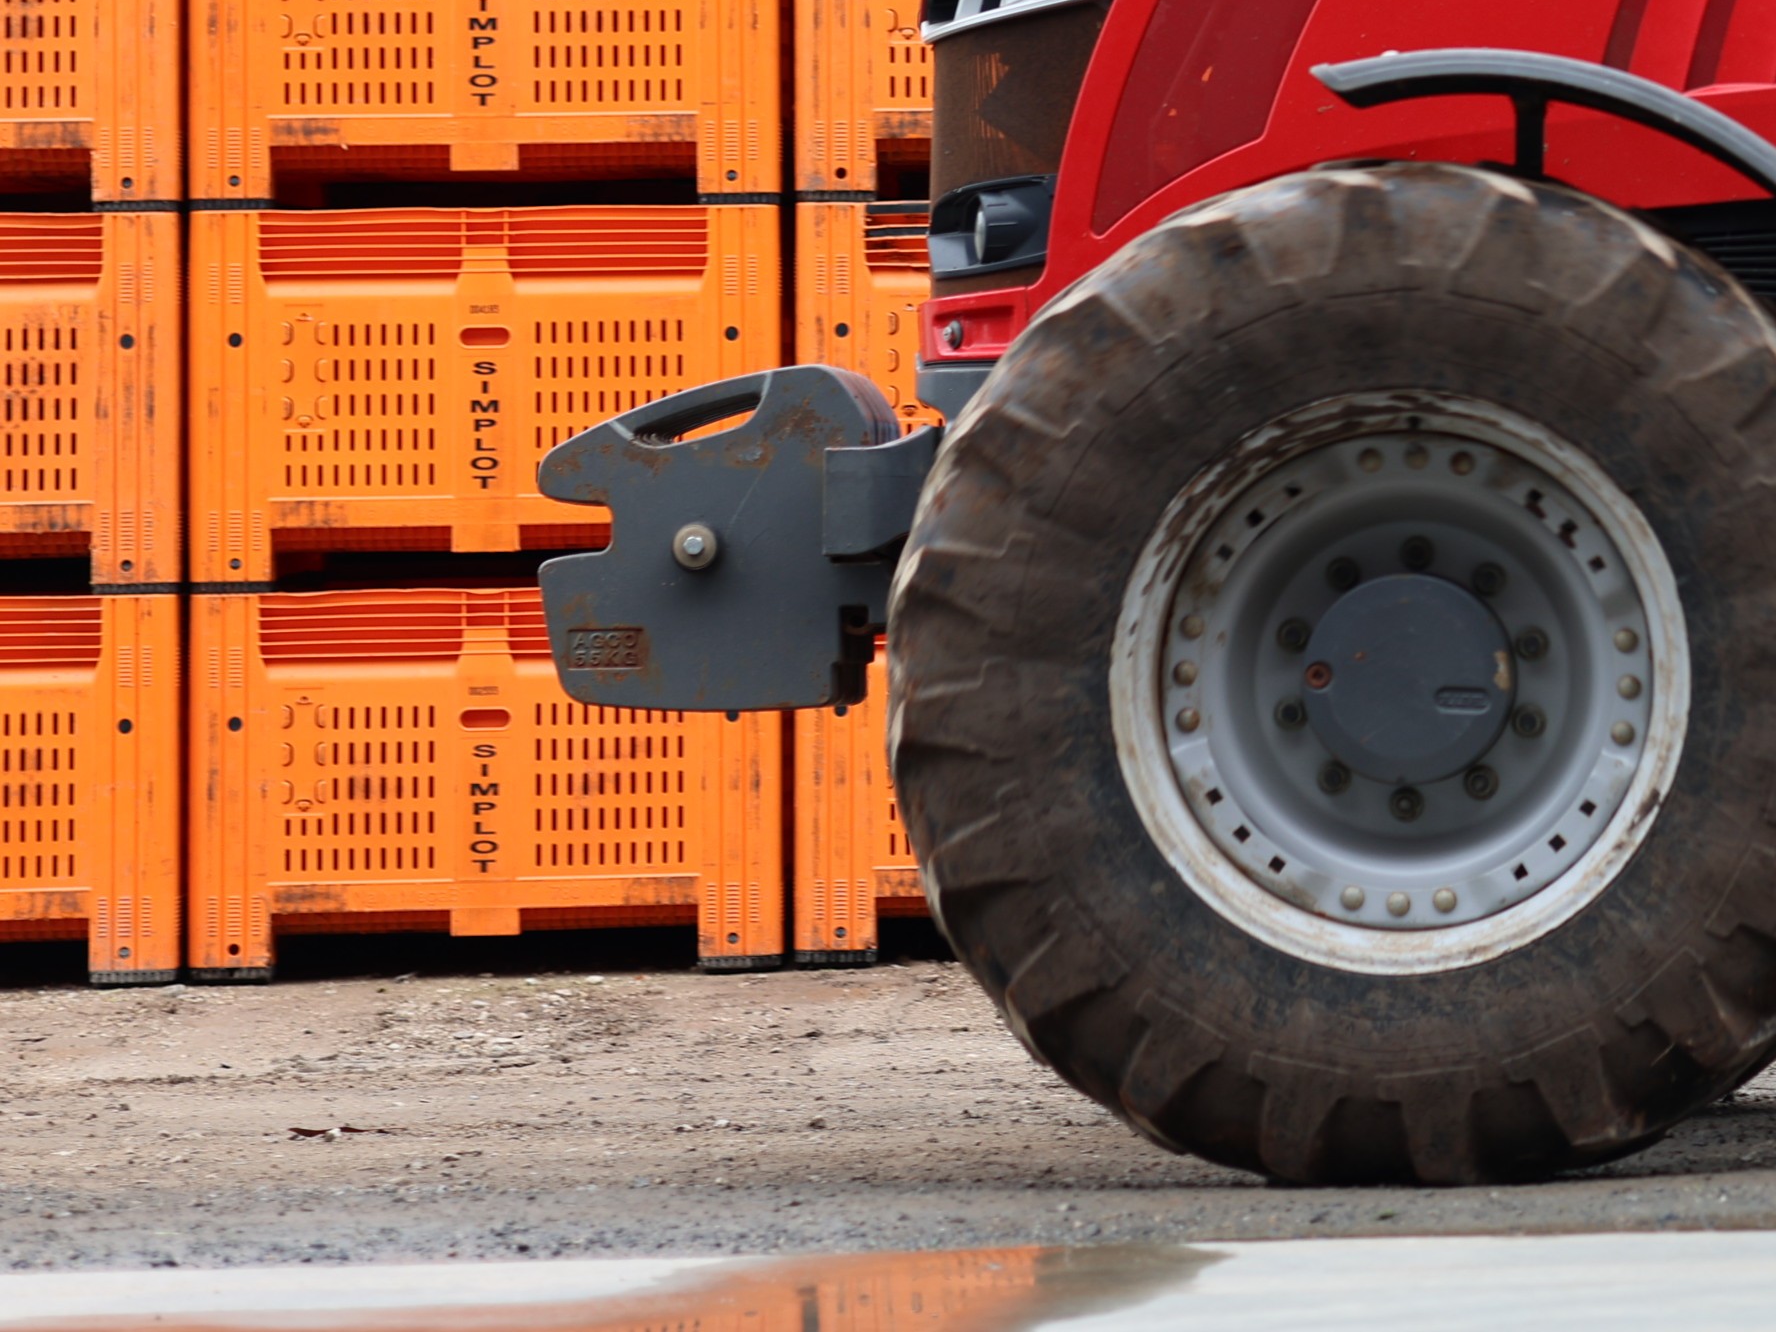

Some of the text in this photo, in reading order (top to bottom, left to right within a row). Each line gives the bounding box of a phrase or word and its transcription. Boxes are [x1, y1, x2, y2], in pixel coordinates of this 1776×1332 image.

[471, 361, 499, 489] SIMPLOT
[573, 631, 639, 650] AGCO
[574, 650, 639, 667] 55KG
[470, 744, 498, 873] SIMPLOT
